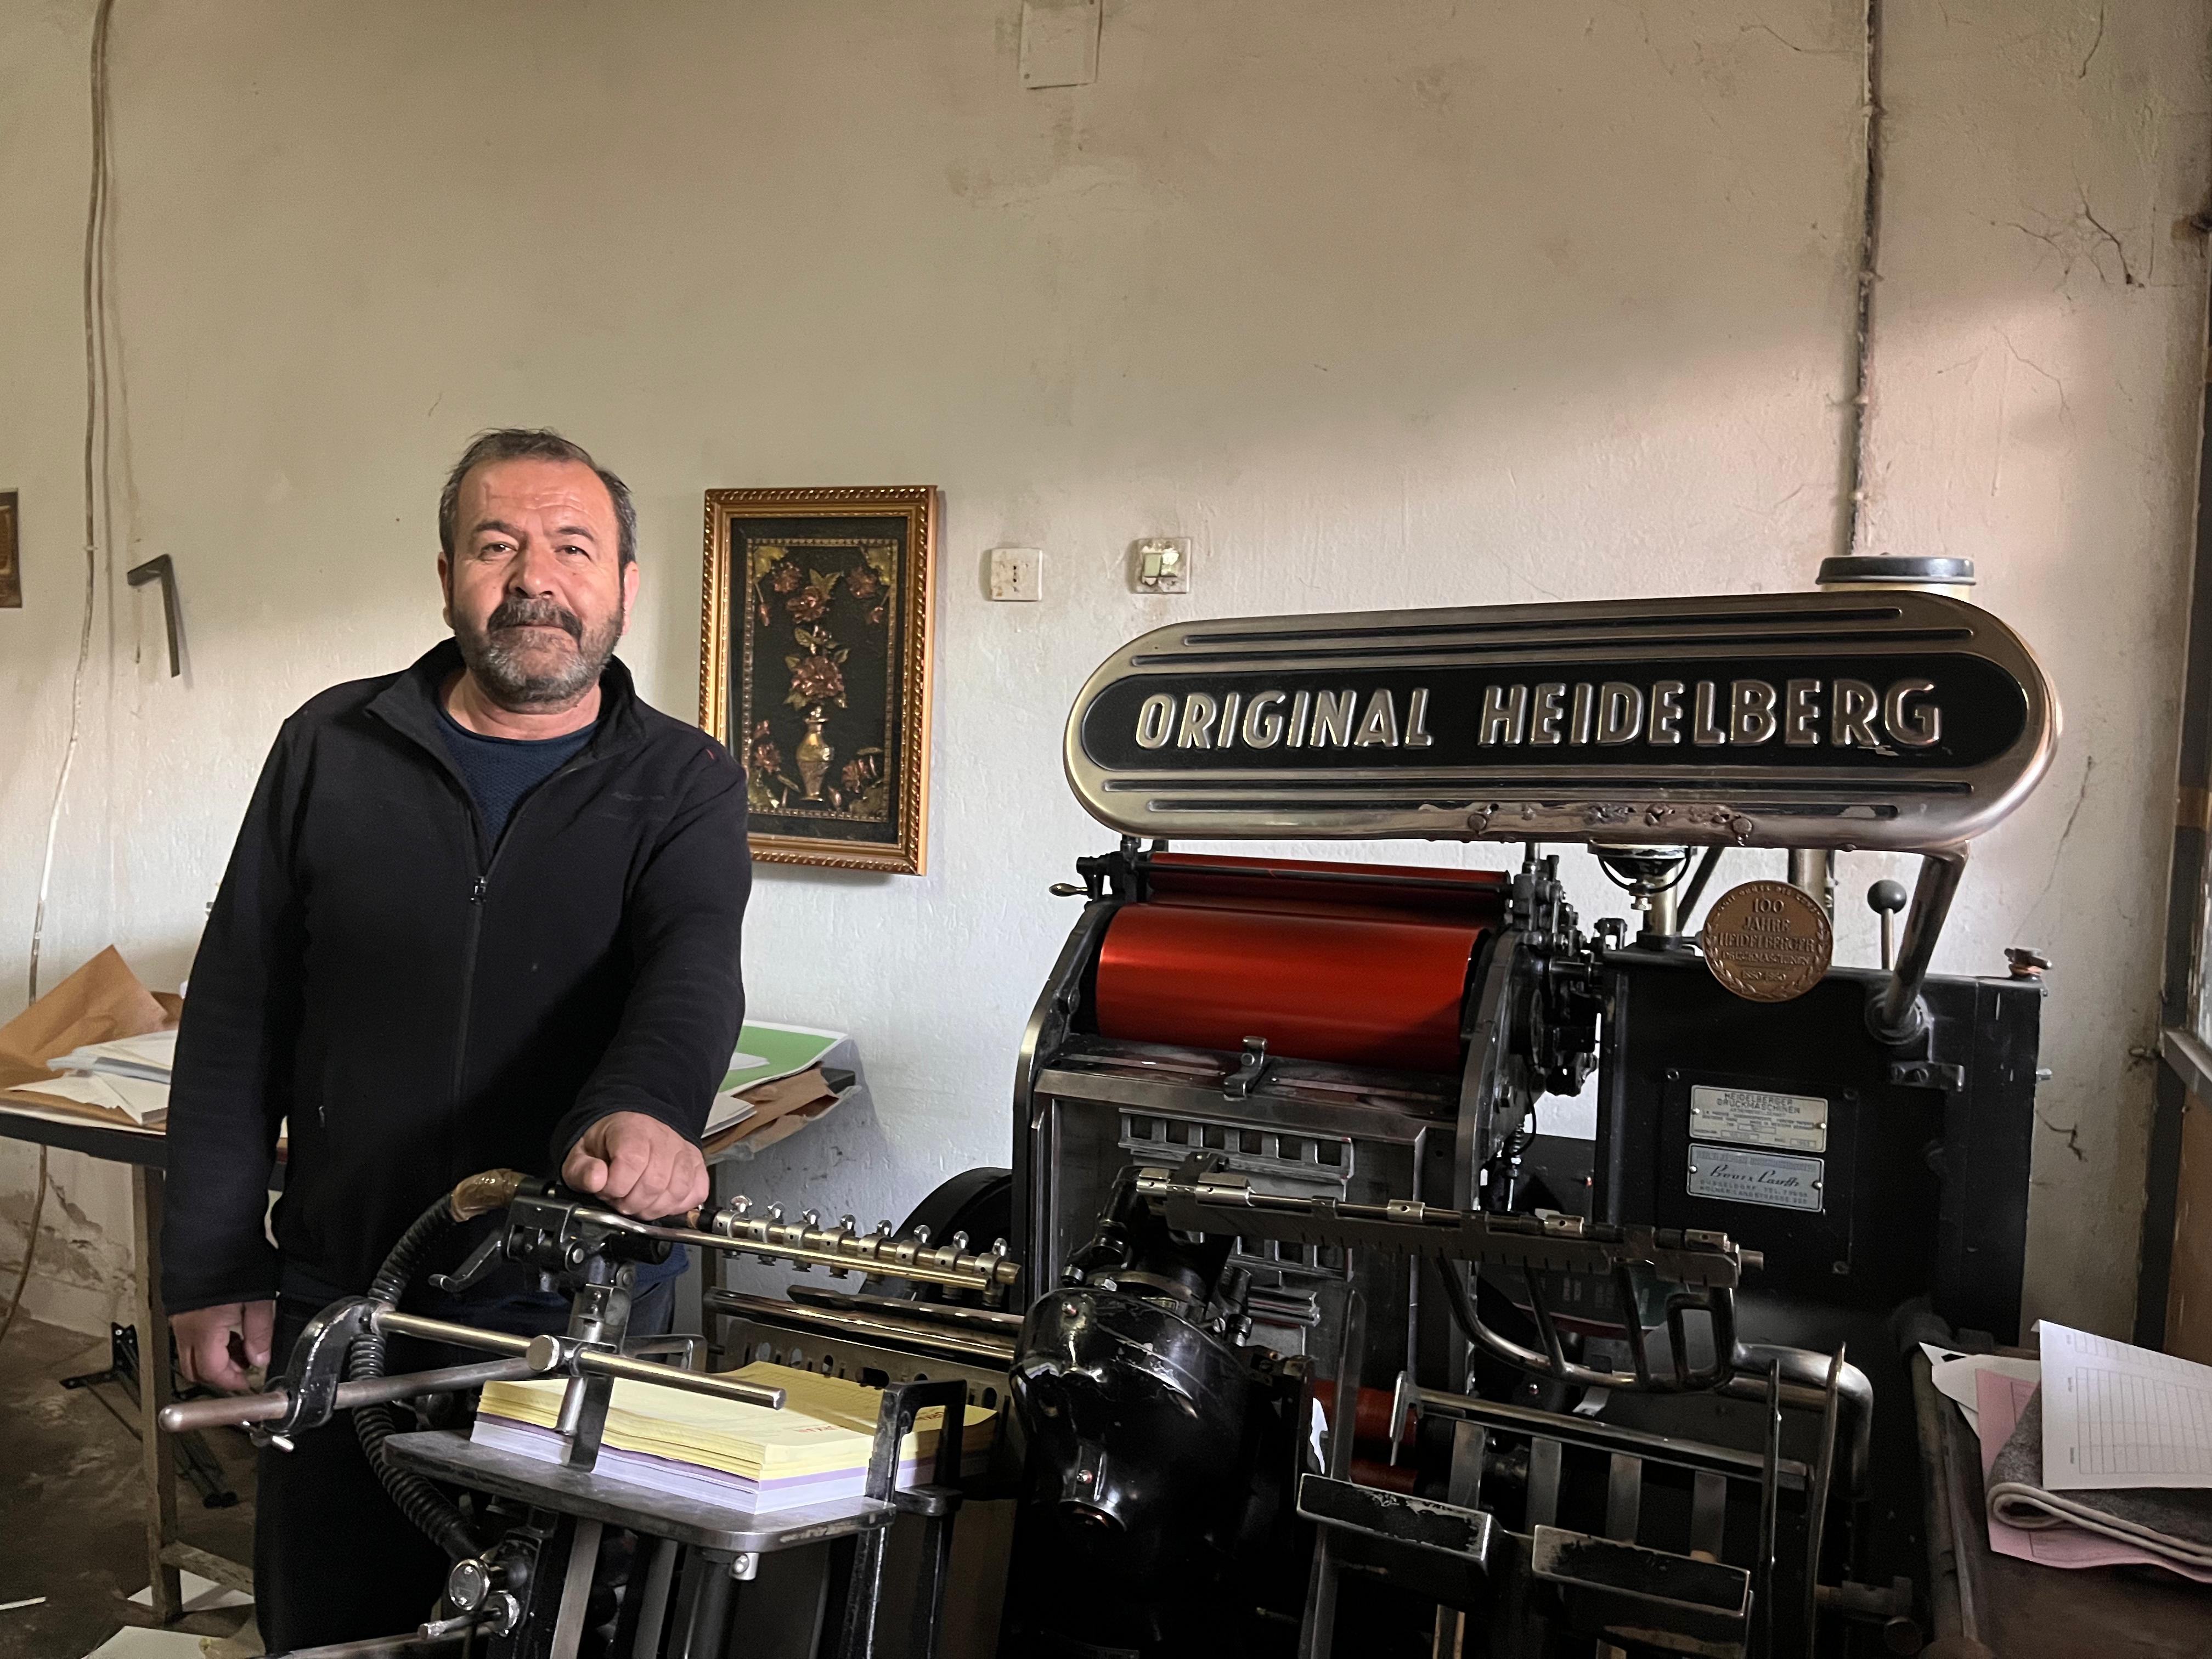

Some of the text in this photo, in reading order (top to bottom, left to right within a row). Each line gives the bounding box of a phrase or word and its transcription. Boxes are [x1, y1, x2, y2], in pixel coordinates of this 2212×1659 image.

[1135, 678, 1943, 750] ORIGINAL HEIDELBERG
[1752, 898, 1785, 913] 100
[1742, 916, 1790, 932] JAHRE
[1718, 932, 1815, 953] HEIDELBERGER
[1716, 1098, 1801, 1114] DRUCKMASCHINEN
[1724, 1092, 1793, 1105] HEIDELBERGER
